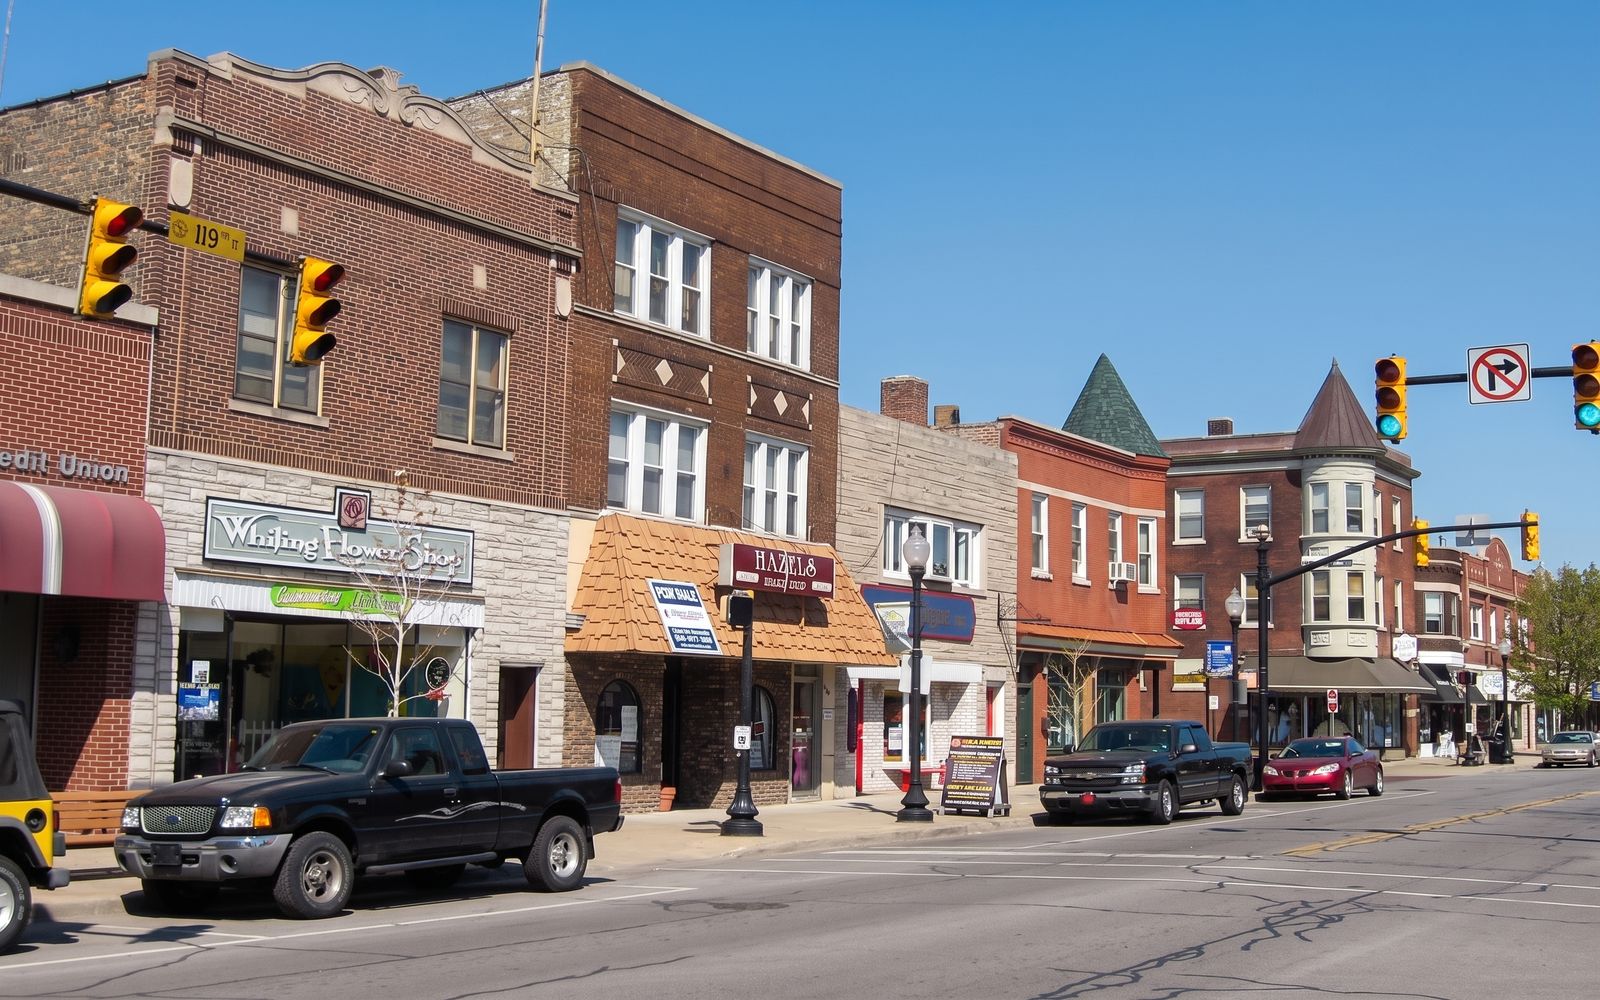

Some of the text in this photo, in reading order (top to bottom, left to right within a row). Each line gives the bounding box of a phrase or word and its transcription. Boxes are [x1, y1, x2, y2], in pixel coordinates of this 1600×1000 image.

[195, 224, 219, 248] 119
[0, 449, 128, 483] edit Union
[320, 525, 401, 563] Flower
[400, 532, 462, 576] Shop
[754, 550, 817, 577] HAZELS
